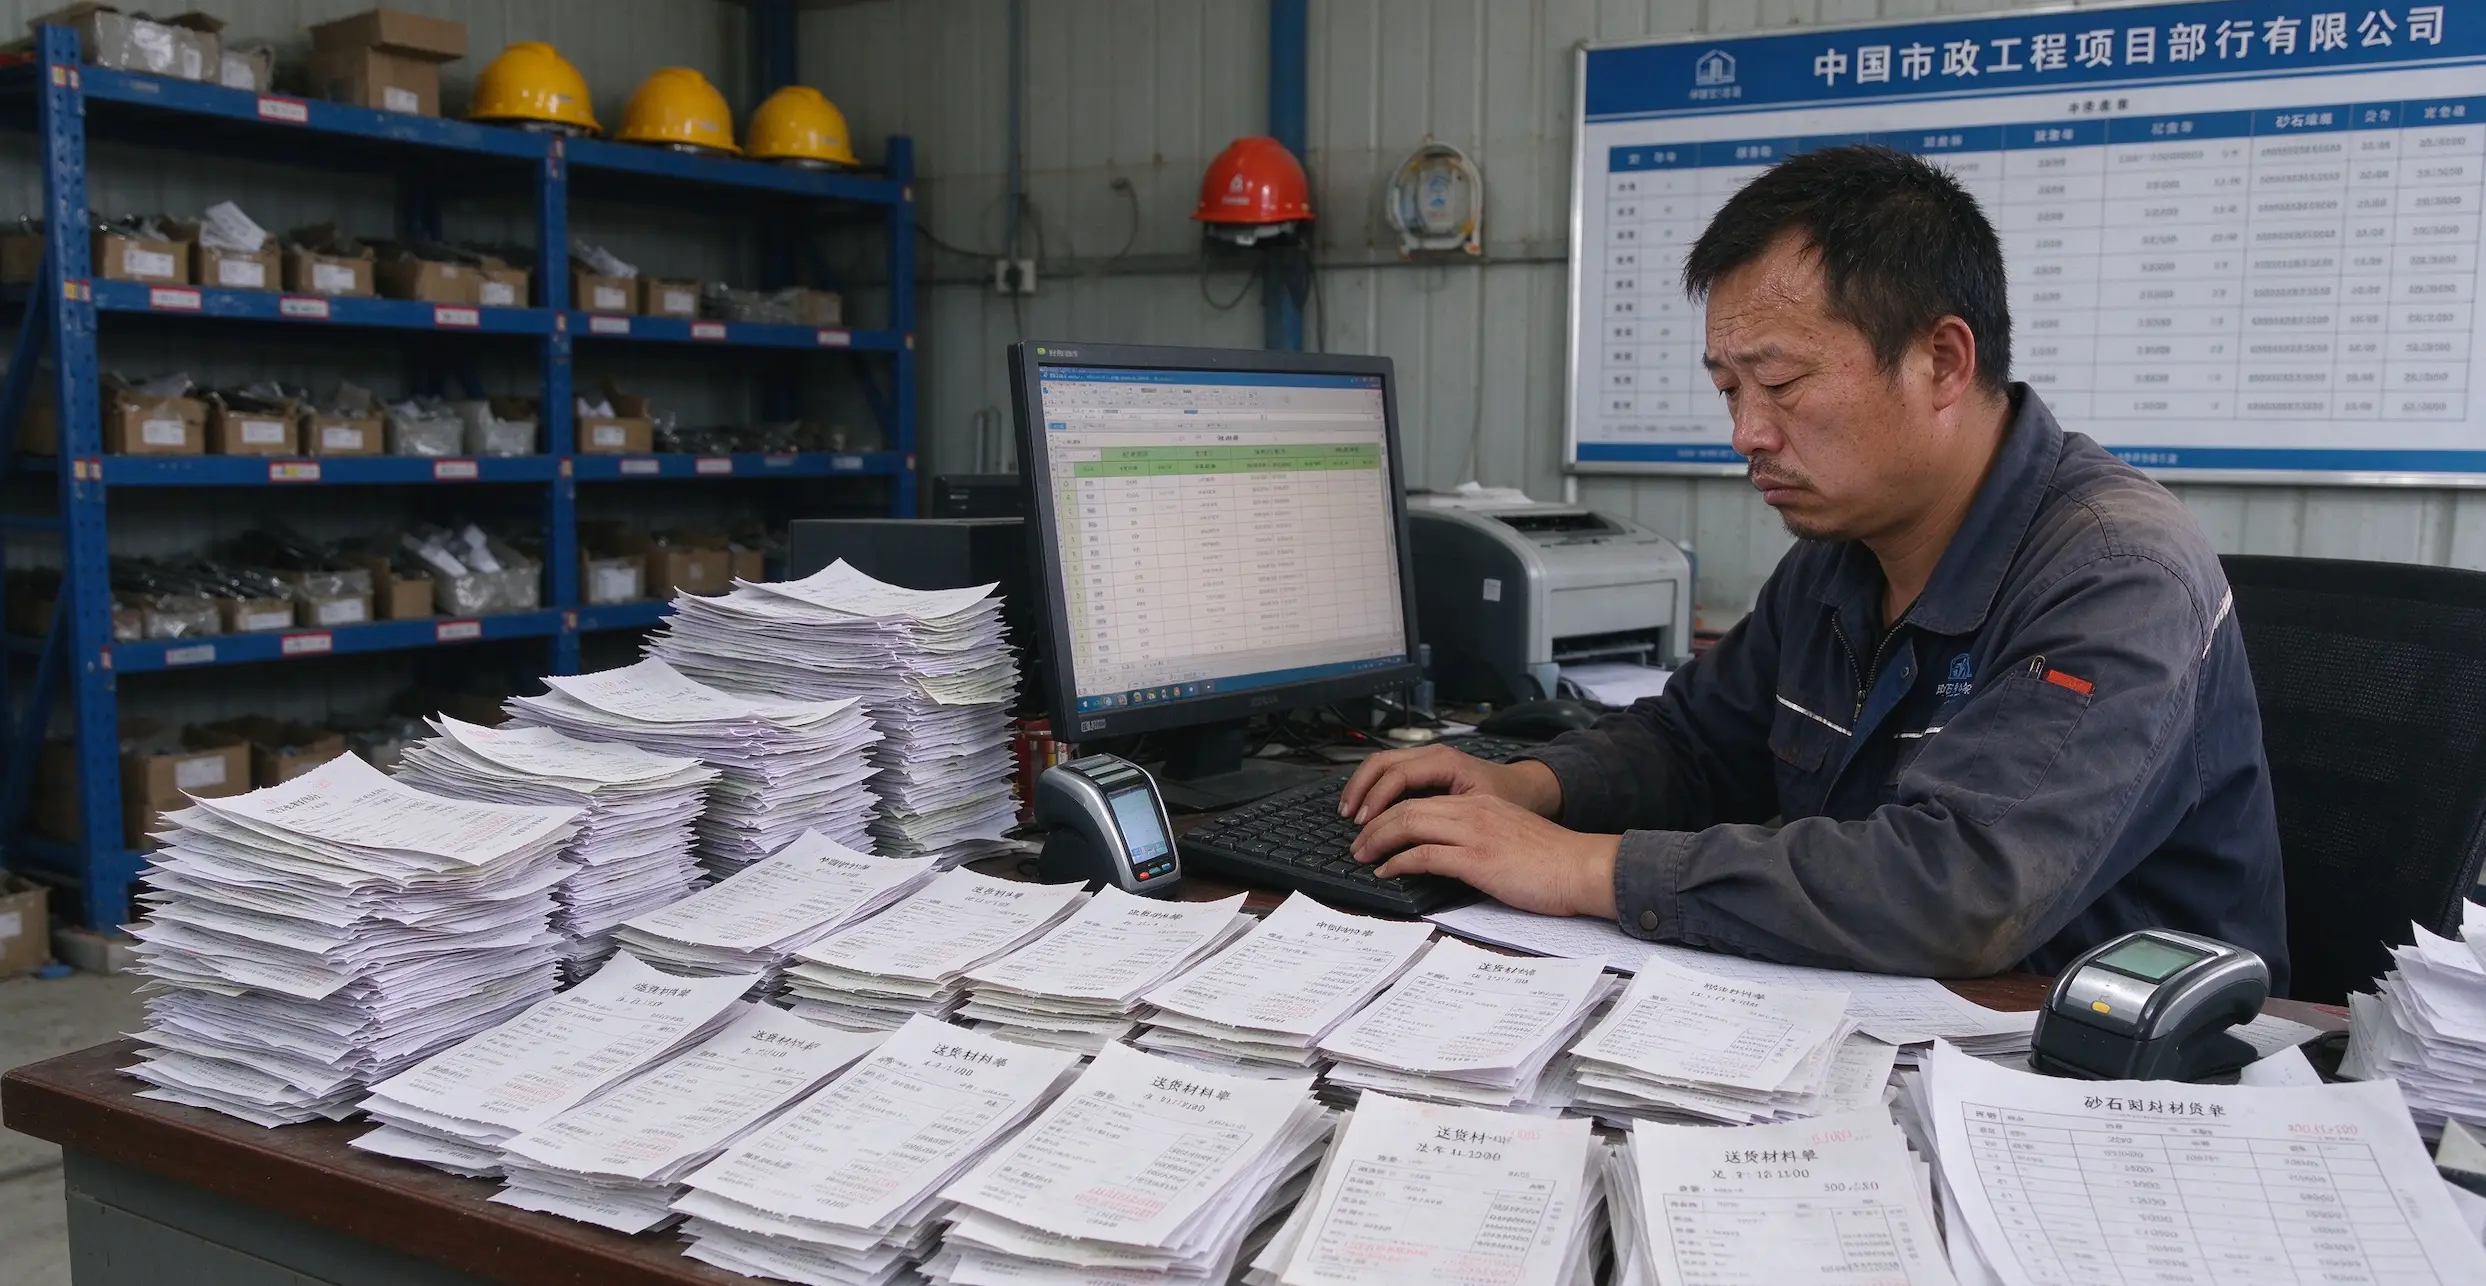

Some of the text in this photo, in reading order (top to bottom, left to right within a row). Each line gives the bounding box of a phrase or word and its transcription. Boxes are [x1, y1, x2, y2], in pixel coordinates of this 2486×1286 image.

[1813, 5, 2444, 87] 中国市政工程项目部行有限公司
